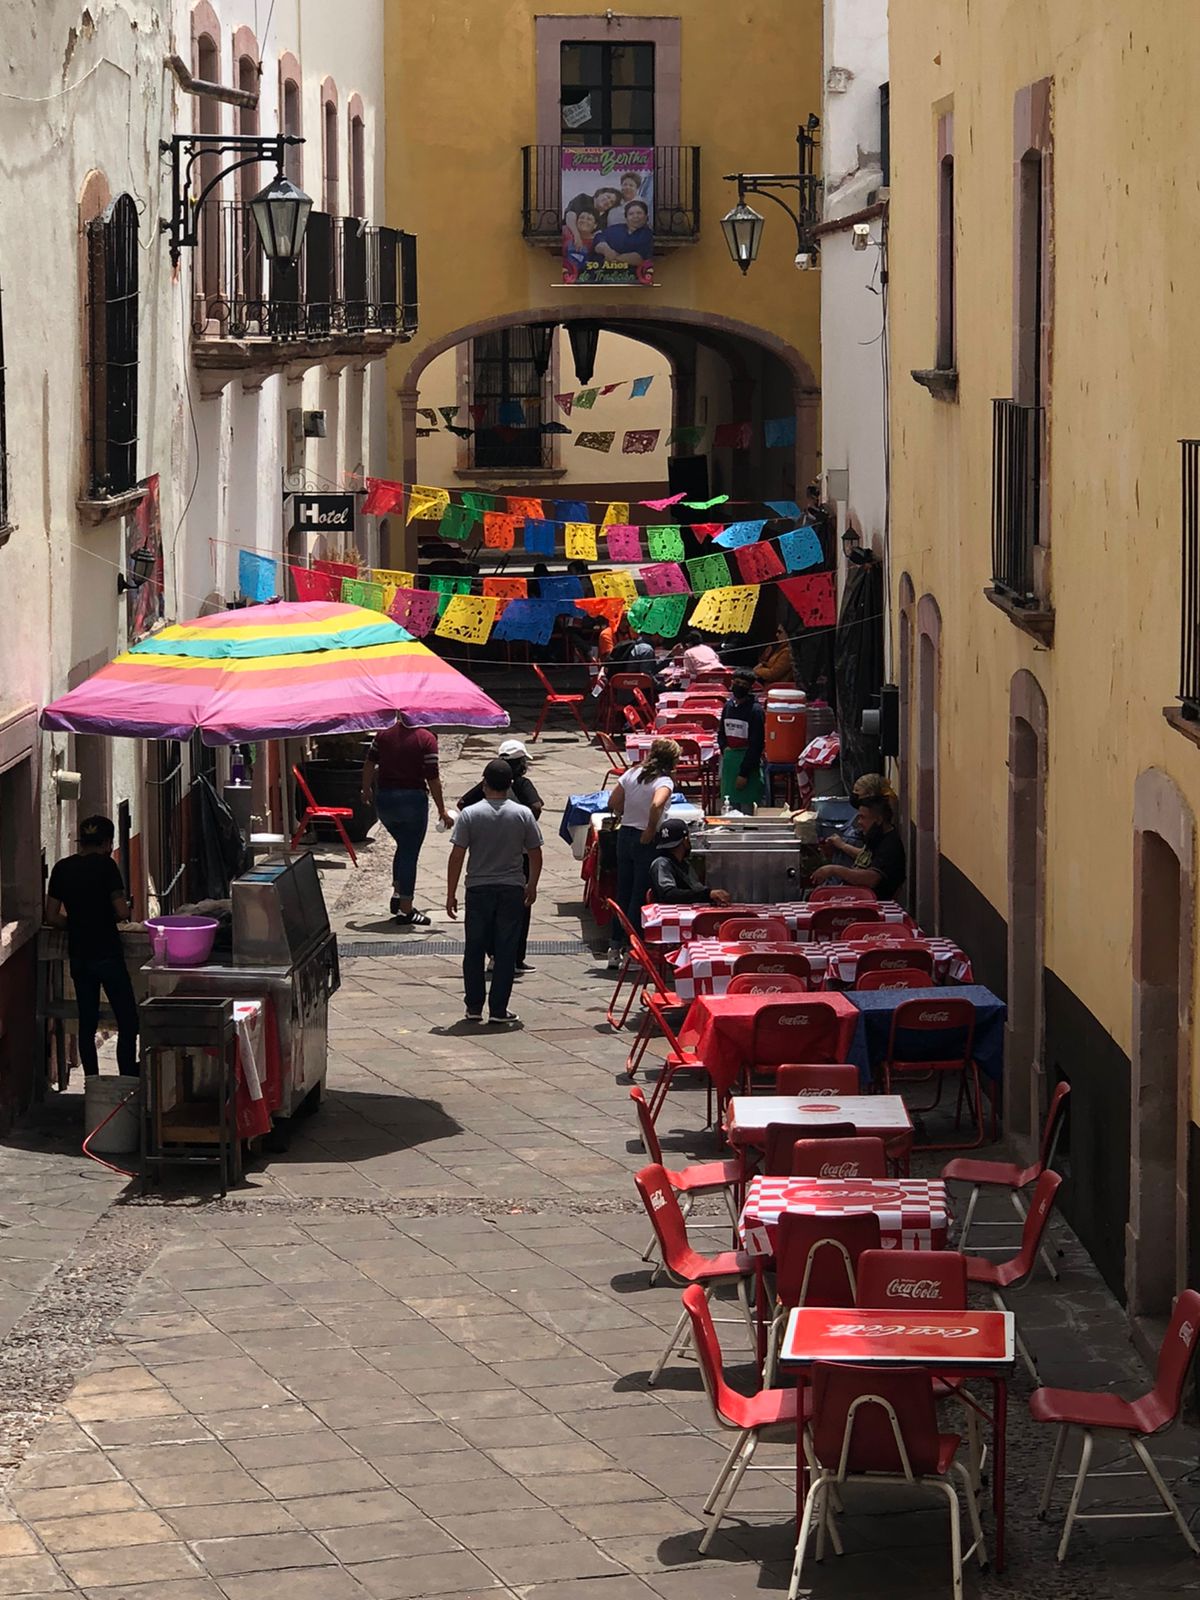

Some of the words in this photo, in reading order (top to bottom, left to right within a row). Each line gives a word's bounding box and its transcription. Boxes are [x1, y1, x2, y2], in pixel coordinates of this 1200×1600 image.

[600, 149, 649, 176] Bertha
[586, 261, 600, 270] 50
[300, 503, 349, 524] Hotel
